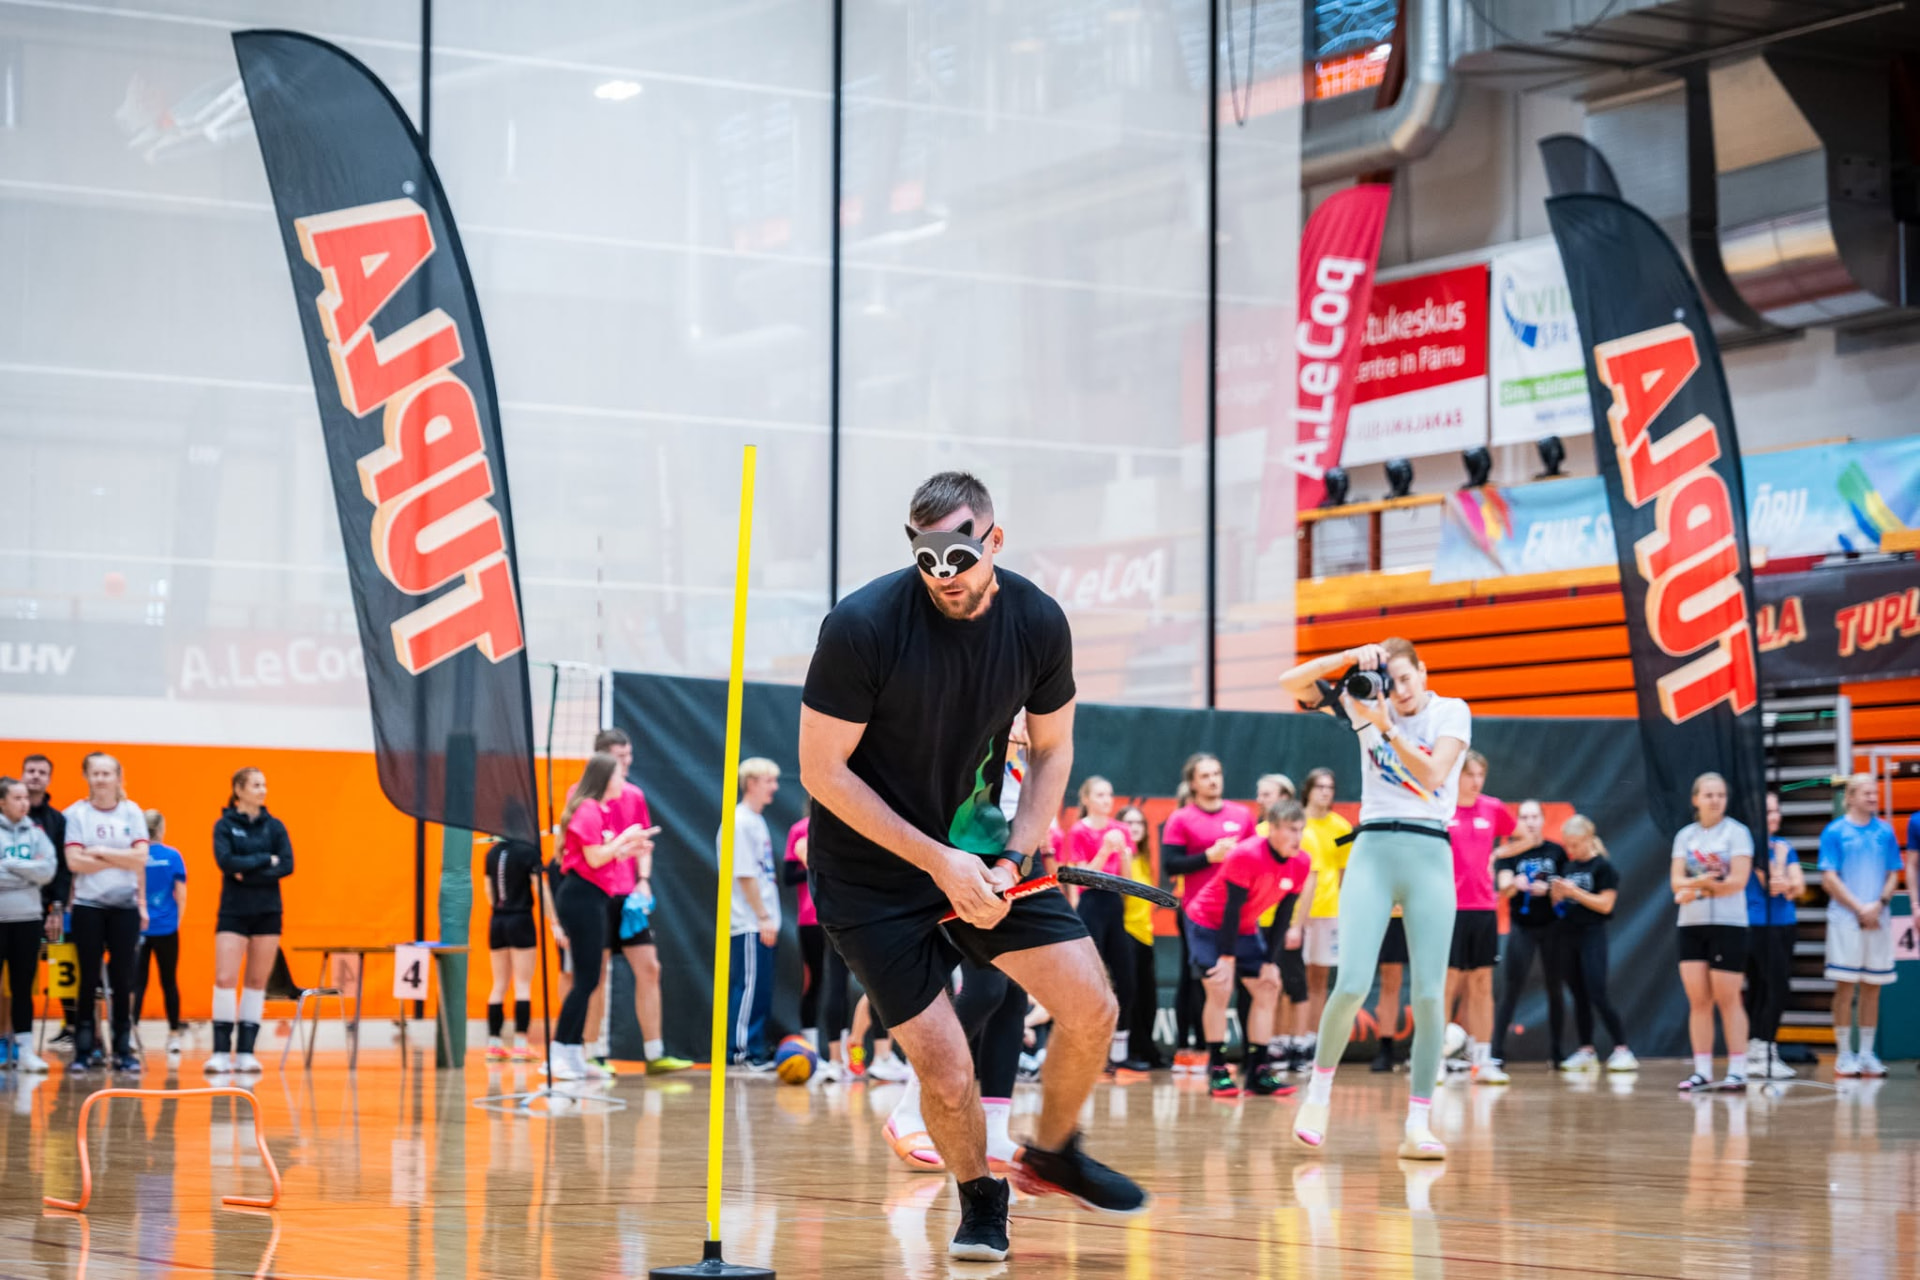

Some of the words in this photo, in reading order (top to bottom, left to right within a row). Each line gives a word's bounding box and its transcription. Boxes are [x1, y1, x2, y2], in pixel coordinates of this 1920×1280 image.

[1360, 298, 1466, 346] tukeskus
[1284, 255, 1366, 480] A.LeCoq
[1354, 355, 1397, 384] entre
[1750, 484, 1809, 536] ÕBU
[1836, 586, 1920, 657] TUPL
[1898, 927, 1915, 951] 4
[57, 962, 76, 987] 3
[402, 960, 422, 988] 4
